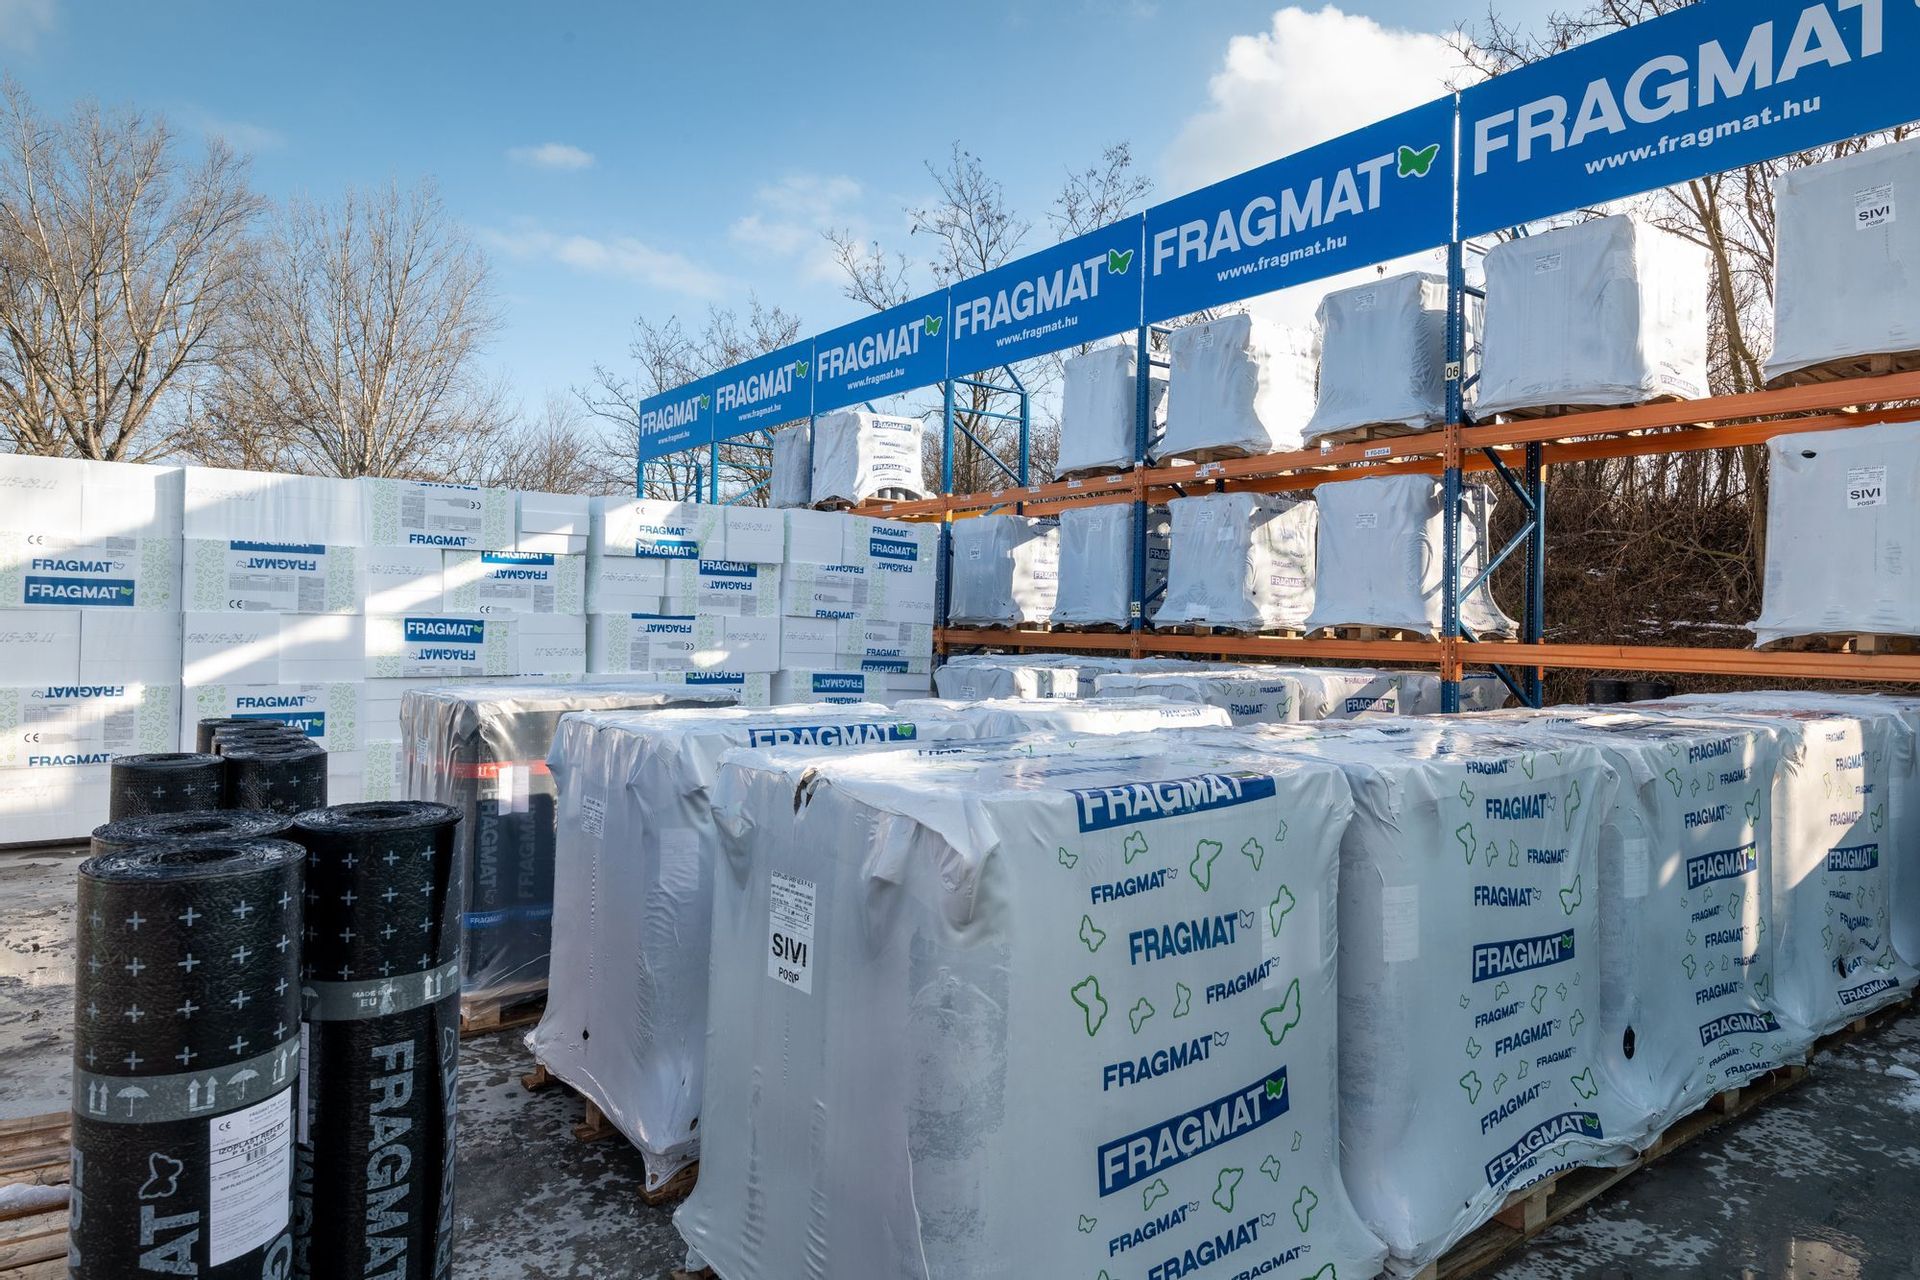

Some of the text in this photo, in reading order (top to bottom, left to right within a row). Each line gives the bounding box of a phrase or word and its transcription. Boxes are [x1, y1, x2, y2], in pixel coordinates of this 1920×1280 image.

[1474, 0, 1883, 176] FRAGMAT
[1585, 96, 1820, 175] www.fragmat.hu
[1153, 152, 1395, 277] FRAGMAT
[1859, 205, 1890, 221] SIVI
[1217, 235, 1347, 282] www.fragmat.hu
[955, 253, 1107, 340] FRAGMAT
[996, 316, 1078, 347] www.fragmat.hu
[818, 318, 925, 383] FRAGMAT
[847, 368, 905, 390] www.fragmat.hu
[1446, 366, 1459, 378] 06
[716, 363, 796, 414] FRAGMAT
[641, 395, 700, 437] FRAGMAT
[738, 404, 781, 421] www.fragmat.hu
[1850, 488, 1881, 500] SIVI
[409, 533, 467, 546] FRAGMAT
[639, 525, 686, 536] FRAGMAT
[872, 526, 908, 538] FRAGMAT
[638, 544, 691, 557] FRAGMAT
[871, 543, 912, 556] FRAGMAT
[1151, 549, 1169, 559] FRAG
[32, 558, 112, 573] FRAGMAT
[247, 558, 317, 571] FRAGMAT
[494, 569, 548, 580] FRAGMAT
[701, 560, 750, 572] FRAGMAT
[878, 562, 913, 573] FRAGMAT
[28, 584, 119, 599] FRAGMAT
[710, 580, 752, 591] FRAGMAT
[815, 609, 855, 620] FRAGMAT
[407, 622, 473, 637] FRAGMAT
[645, 623, 692, 634] FRAGMAT
[418, 649, 476, 661] FRAGMAT
[866, 649, 901, 657] FRAGMAT
[45, 686, 124, 699] FRAGMAT
[820, 678, 863, 689] FRAGMAT
[1260, 685, 1285, 694] FRAGMAT
[236, 696, 306, 708] FRAGMAT
[1231, 703, 1264, 716] FRAGMAT
[1347, 699, 1388, 712] FRAGMAT
[754, 723, 892, 748] FRAGMAT
[29, 753, 110, 767] FRAGMAT
[1689, 738, 1733, 764] FRAGMAT
[1466, 760, 1508, 775] FRAGMAT
[1836, 752, 1866, 772] FRAGMAT
[1720, 768, 1750, 786] FRAGMAT
[1083, 773, 1243, 825] FRAGMAT
[1486, 793, 1547, 820] FRAGMAT
[1684, 806, 1726, 829] FRAGMAT
[1830, 811, 1859, 827] FRAGMAT
[480, 789, 500, 887] FRAGMAT
[1527, 849, 1565, 864] FRAGMAT
[1829, 850, 1872, 870] FRAGMAT
[1689, 848, 1748, 886] FRAGMAT
[1090, 869, 1167, 905] FRAGMAT
[1474, 885, 1533, 907] FRAGMAT
[1691, 906, 1720, 923] FRAGMAT
[1840, 912, 1870, 932] FRAGMAT
[1129, 912, 1238, 965] FRAGMAT
[1705, 928, 1744, 948] FRAGMAT
[772, 932, 807, 968] SIVI
[1475, 937, 1562, 979] FRAGMAT
[1206, 960, 1272, 1004] FRAGMAT
[1840, 978, 1890, 1004] FRAGMAT
[352, 990, 377, 998] MADE
[360, 997, 377, 1007] EU
[1695, 982, 1738, 1005] FRAGMAT
[1475, 1002, 1519, 1028] FRAGMAT
[1495, 1020, 1553, 1058] FRAGMAT
[1702, 1015, 1769, 1045] FRAGMAT
[1103, 1034, 1213, 1091] FRAGMAT
[1536, 1048, 1572, 1068] FRAGMAT
[1709, 1049, 1740, 1069] FRAGMAT
[1724, 1061, 1772, 1078] FRAGMAT
[1480, 1084, 1541, 1135] FRAGMAT
[219, 1121, 231, 1131] CE
[219, 1134, 259, 1155] IZOPLAST
[1103, 1085, 1265, 1190] FRAGMAT
[1488, 1114, 1585, 1183] FRAGMAT
[364, 1039, 415, 1280] FRAGMAT
[1109, 1205, 1188, 1257] FRAGMAT
[1147, 1217, 1260, 1280] FRAGMAT
